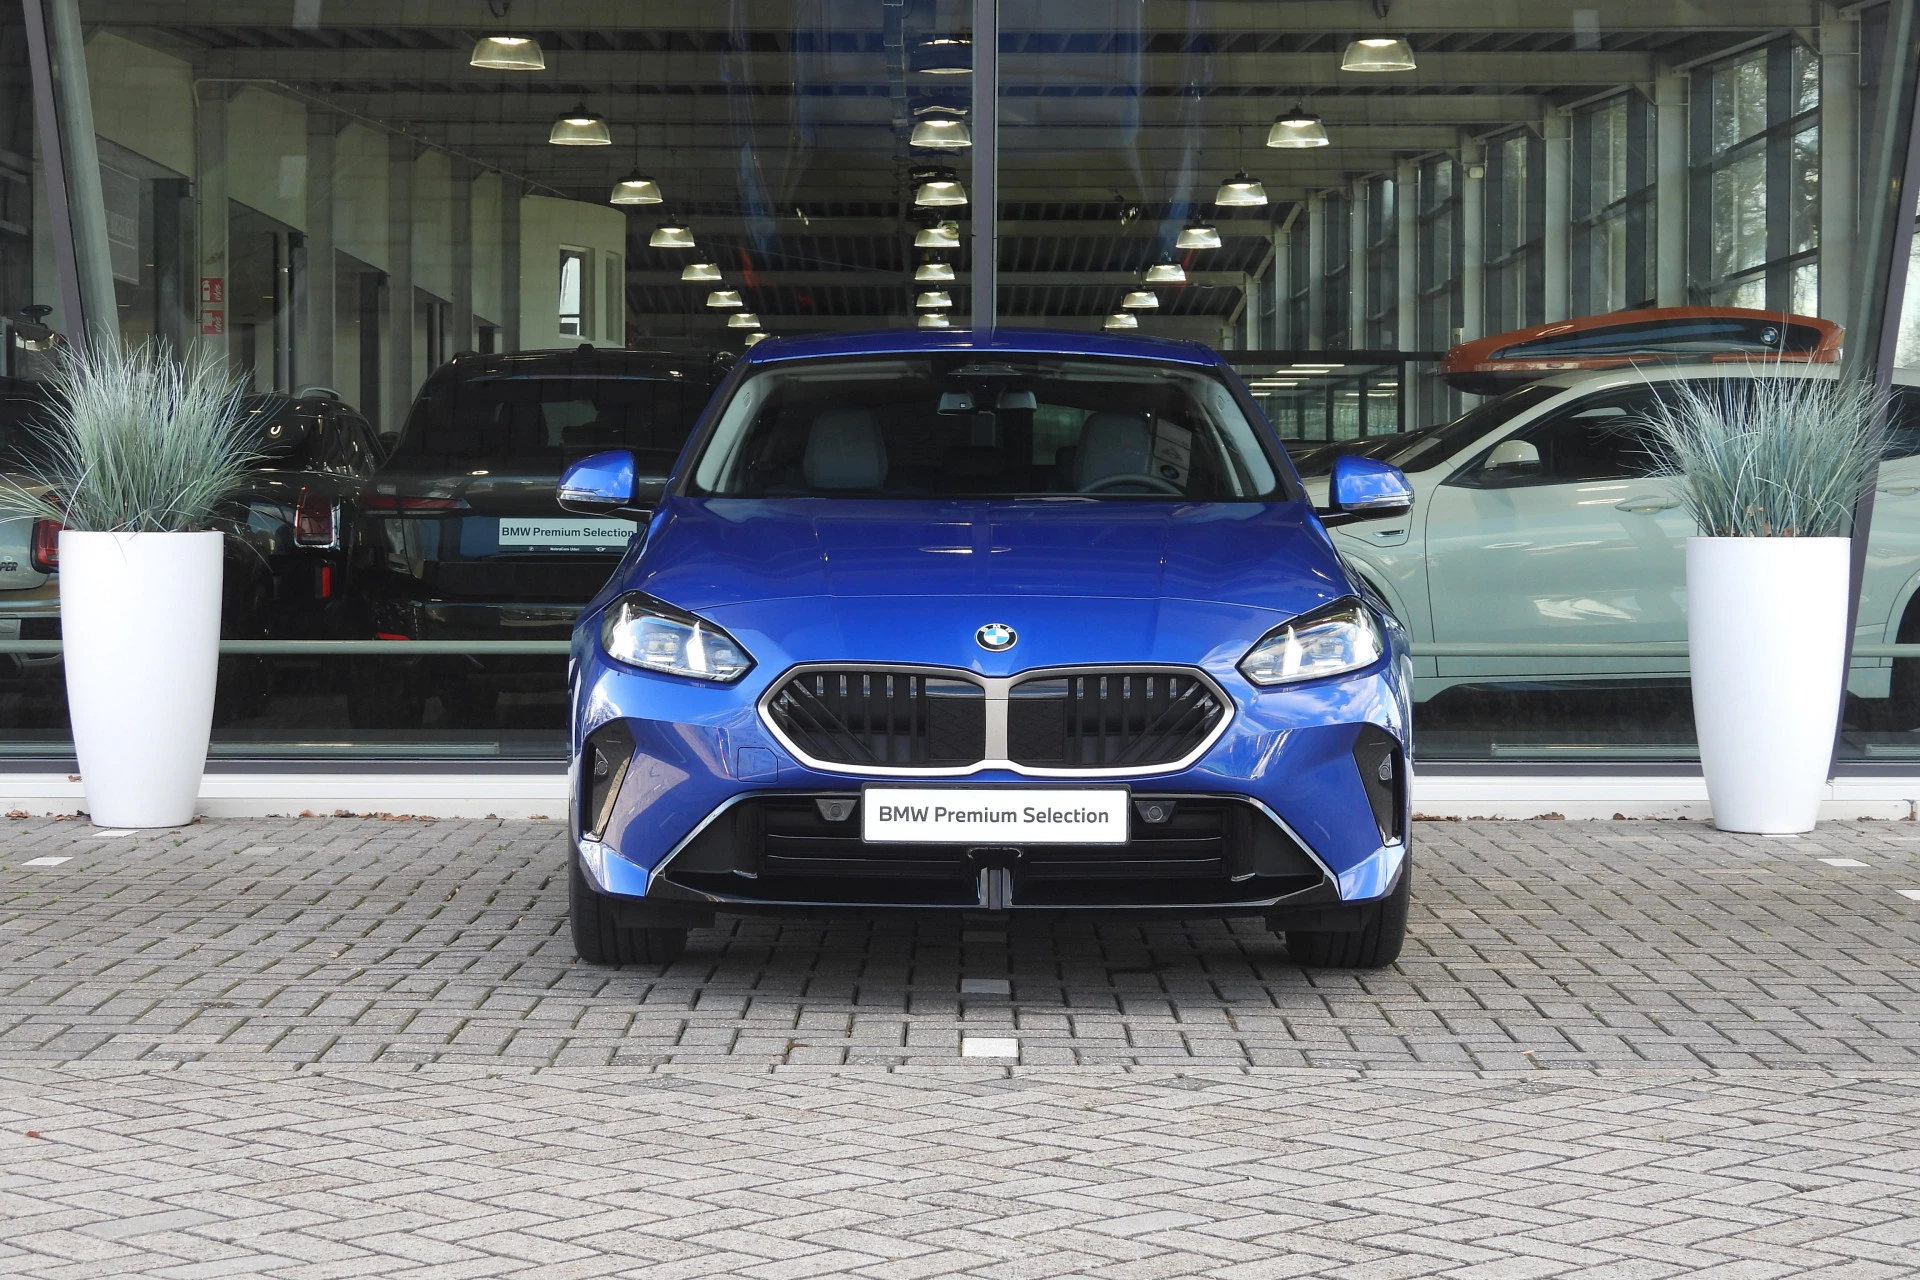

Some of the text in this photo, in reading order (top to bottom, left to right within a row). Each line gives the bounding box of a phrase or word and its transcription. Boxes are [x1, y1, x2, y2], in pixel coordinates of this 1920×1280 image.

[502, 527, 634, 538] BMW Premium Selection
[879, 806, 1109, 824] BMW Premium Selection
